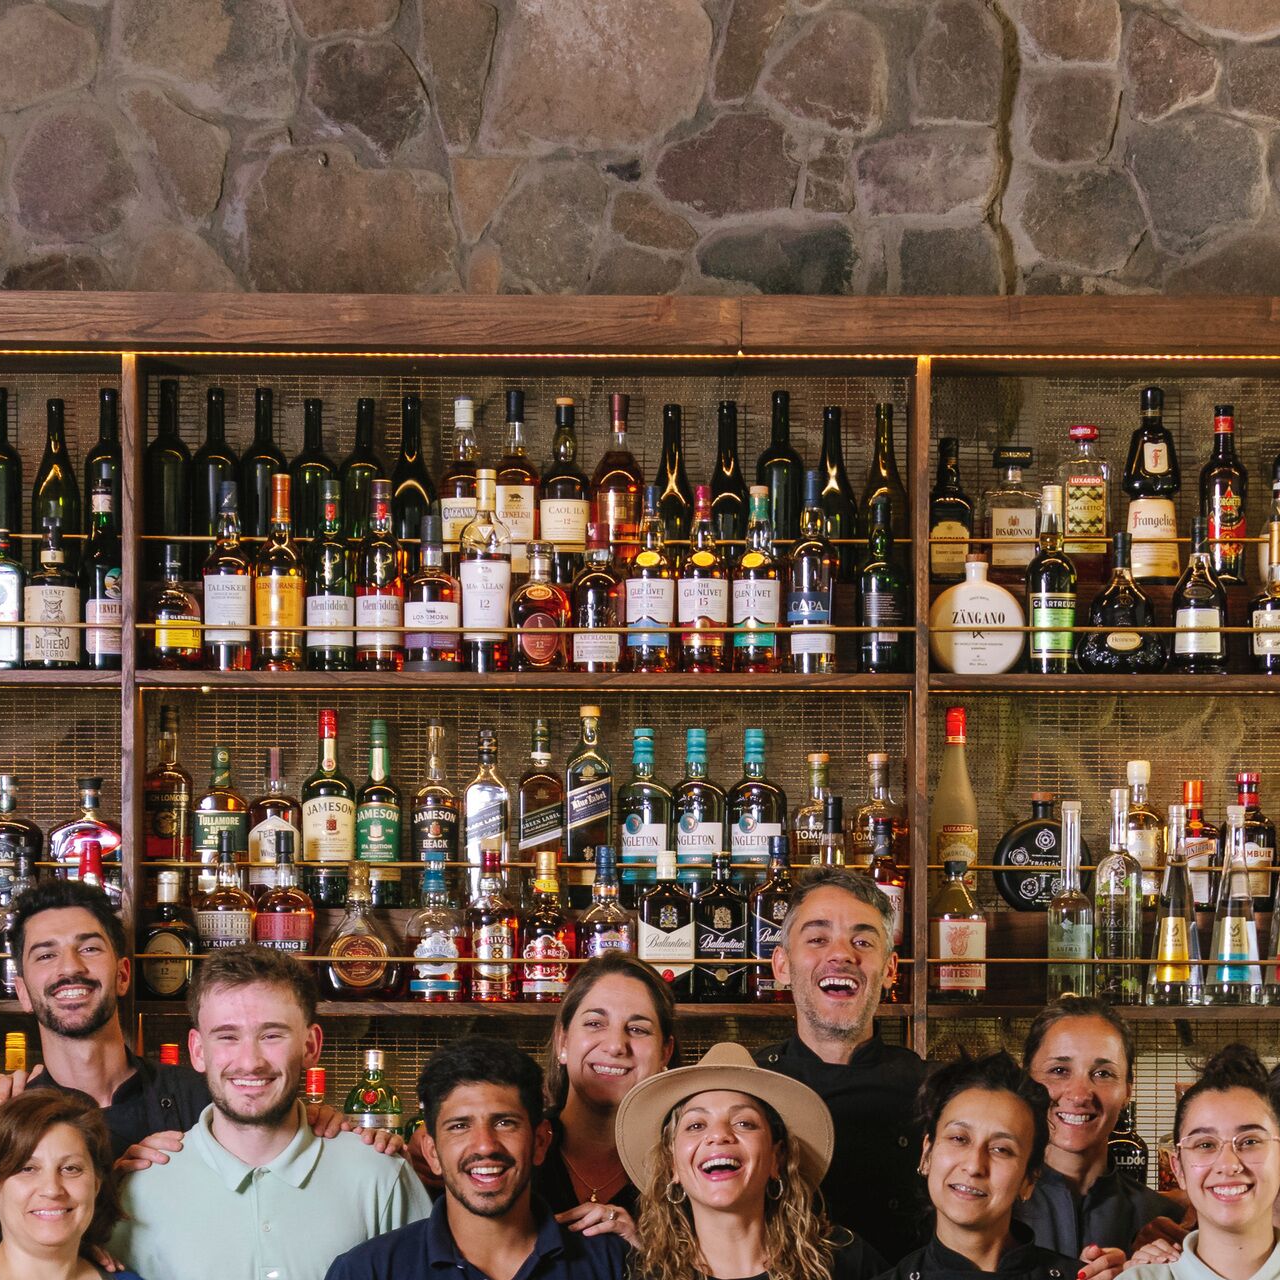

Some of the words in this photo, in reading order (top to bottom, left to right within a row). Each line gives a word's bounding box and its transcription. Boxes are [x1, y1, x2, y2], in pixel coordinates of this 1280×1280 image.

[549, 506, 572, 515] CAOL
[573, 507, 585, 515] ILA
[1132, 511, 1176, 528] Frangelico
[995, 527, 1033, 536] DISARONNO
[208, 584, 247, 592] TALISKER
[257, 582, 304, 590] GLENORANGIE
[41, 588, 66, 597] FERNET
[683, 588, 723, 598] GLNLIVET
[734, 588, 772, 599] GLENIVET
[479, 599, 491, 609] 12
[699, 597, 709, 606] 15
[95, 603, 118, 613] ERNET
[952, 608, 1006, 624] ZÄNGANO
[35, 635, 70, 649] BUHERO
[535, 641, 545, 649] 12
[40, 649, 65, 657] NEGRO
[306, 801, 354, 817] JAMESON
[198, 814, 240, 826] TULLAMORE
[357, 808, 400, 823] JAMESON
[413, 809, 457, 824] JAMESON
[522, 819, 541, 830] GREEN
[542, 812, 561, 823] LABEL
[732, 834, 768, 847] INGLETO
[212, 940, 237, 948] KING
[275, 941, 299, 950] KING
[159, 967, 169, 976] 12
[1114, 1156, 1146, 1165] LLDOG
